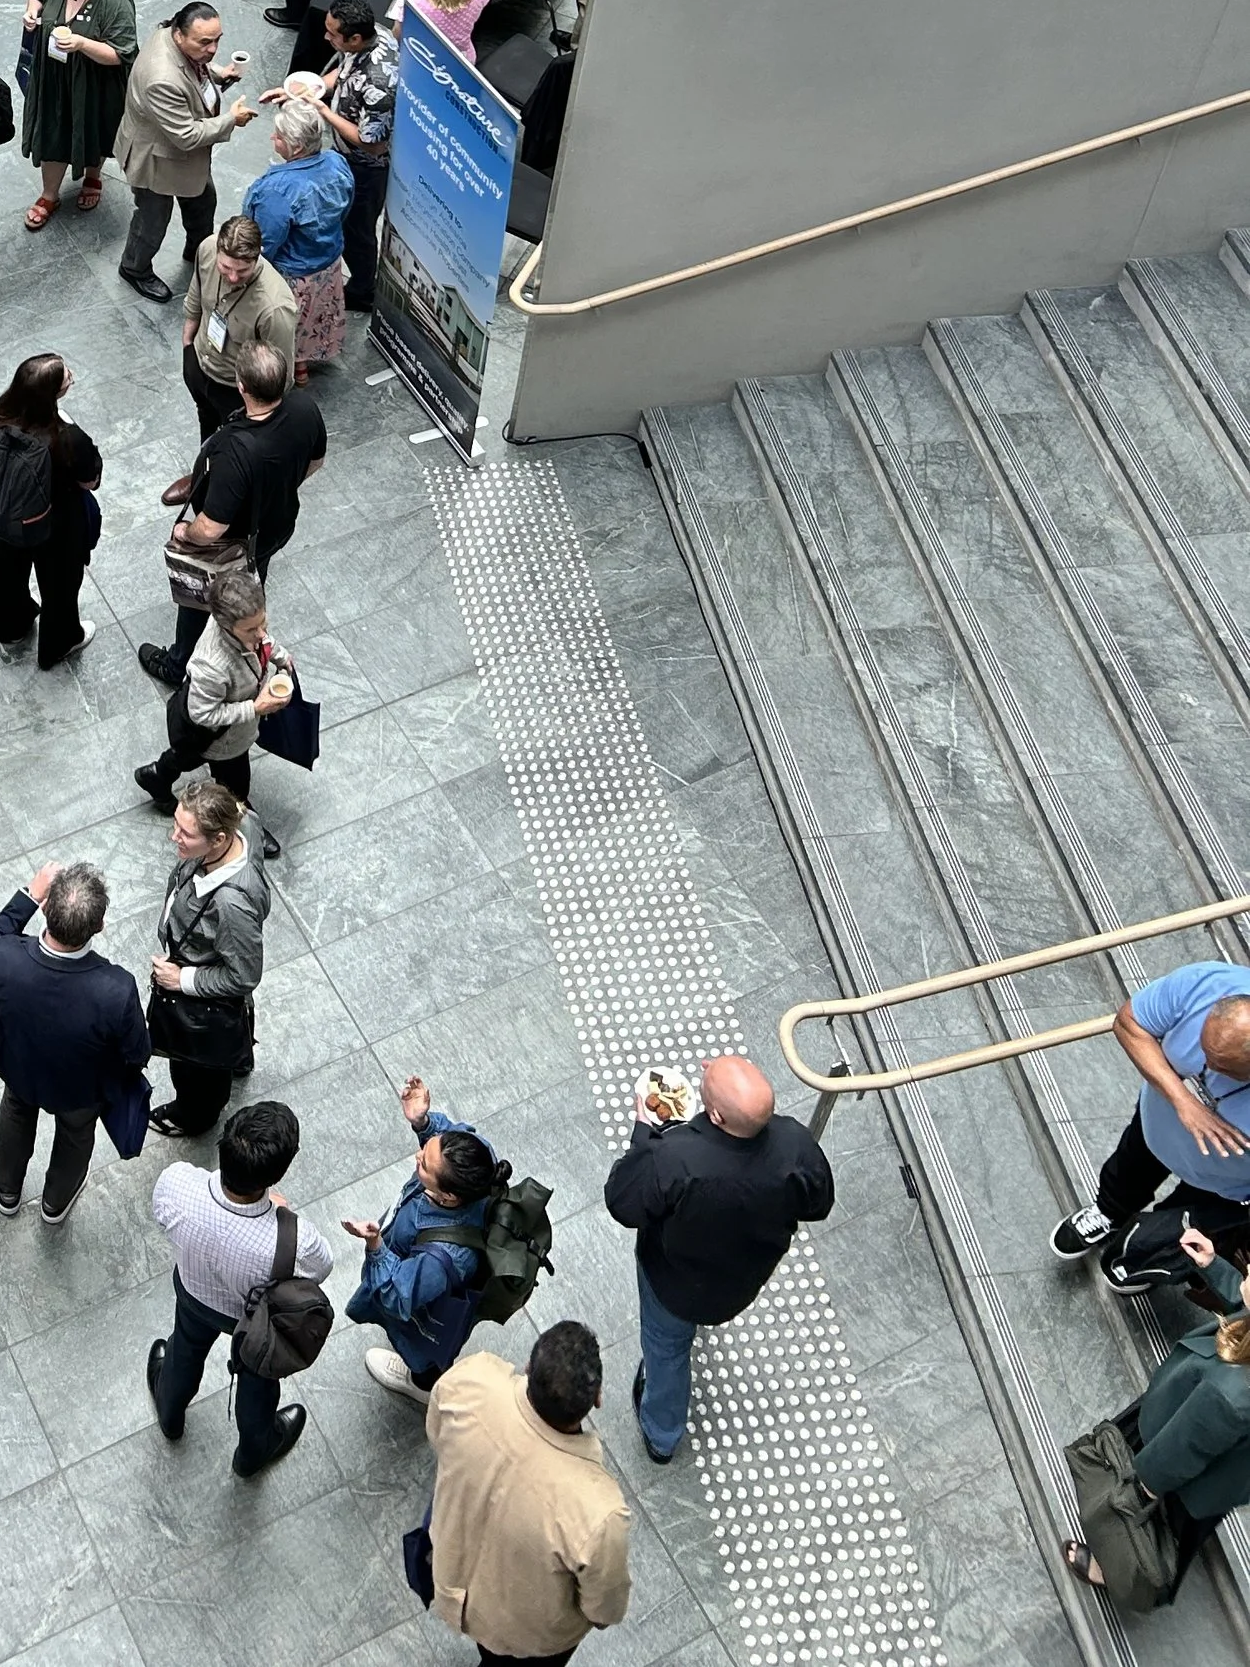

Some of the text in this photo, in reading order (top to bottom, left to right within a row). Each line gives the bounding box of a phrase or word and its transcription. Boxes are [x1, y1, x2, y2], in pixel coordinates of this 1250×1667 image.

[403, 36, 508, 147] Signature
[445, 90, 499, 154] CONSTRUCTION
[399, 79, 436, 125] Provider
[437, 121, 448, 137] of
[449, 136, 502, 200] community
[409, 108, 484, 197] housing for over
[426, 143, 465, 192] 40 years
[418, 176, 453, 218] Delivering
